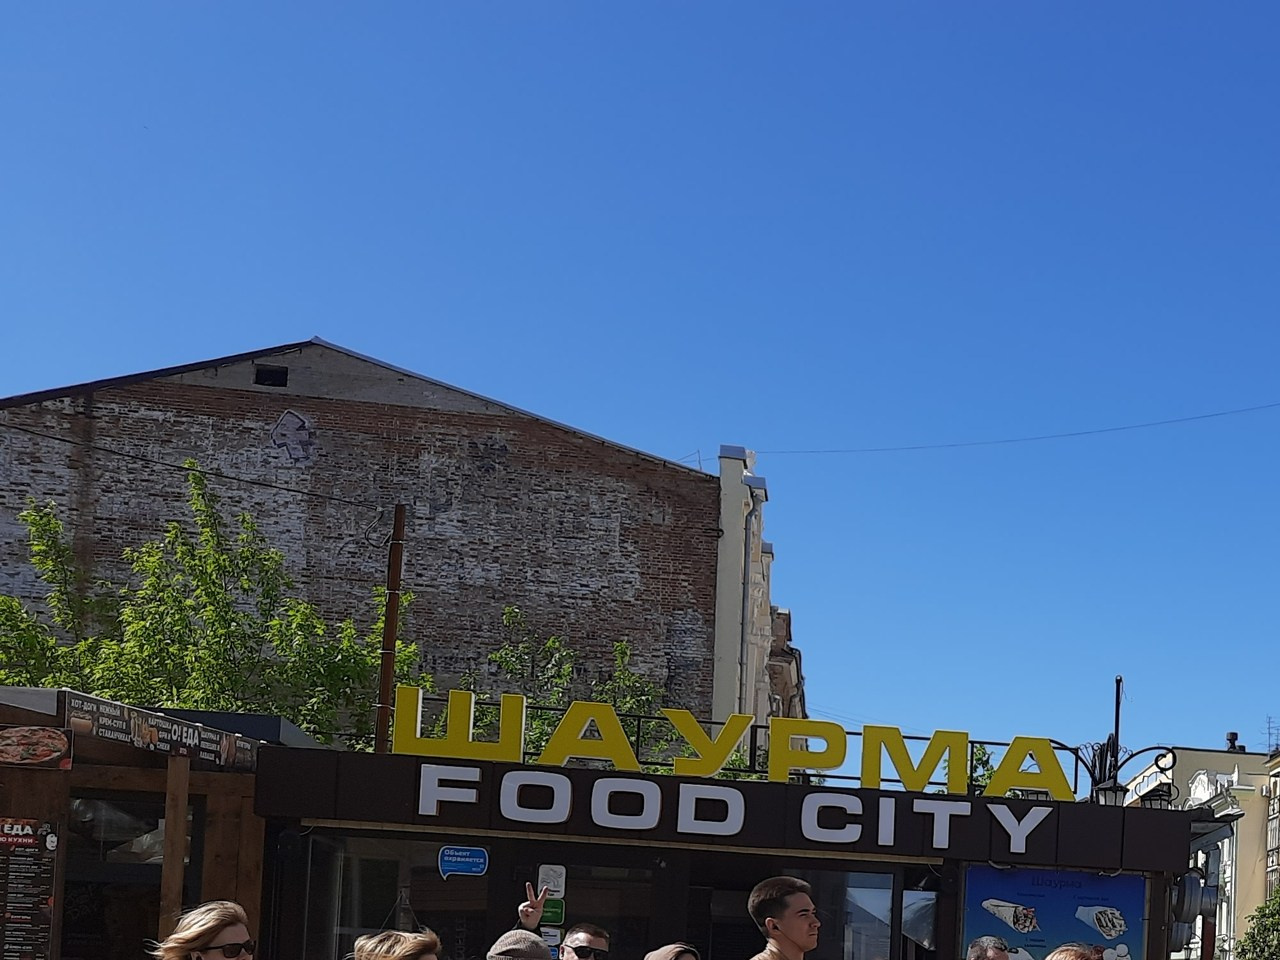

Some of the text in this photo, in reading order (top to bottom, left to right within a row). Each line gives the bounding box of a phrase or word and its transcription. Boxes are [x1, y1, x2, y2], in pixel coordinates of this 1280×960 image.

[71, 699, 97, 712] ХОТ-ДОГИ
[148, 717, 171, 730] КАРТОШКА
[171, 724, 181, 742] О!
[182, 727, 199, 748] ЕДА
[392, 685, 1076, 801] ШАУРМА
[418, 763, 1054, 854] FOOD CITY
[4, 824, 33, 835] ЕДА
[444, 849, 471, 857] Объект
[1031, 876, 1082, 890] Шаурма
